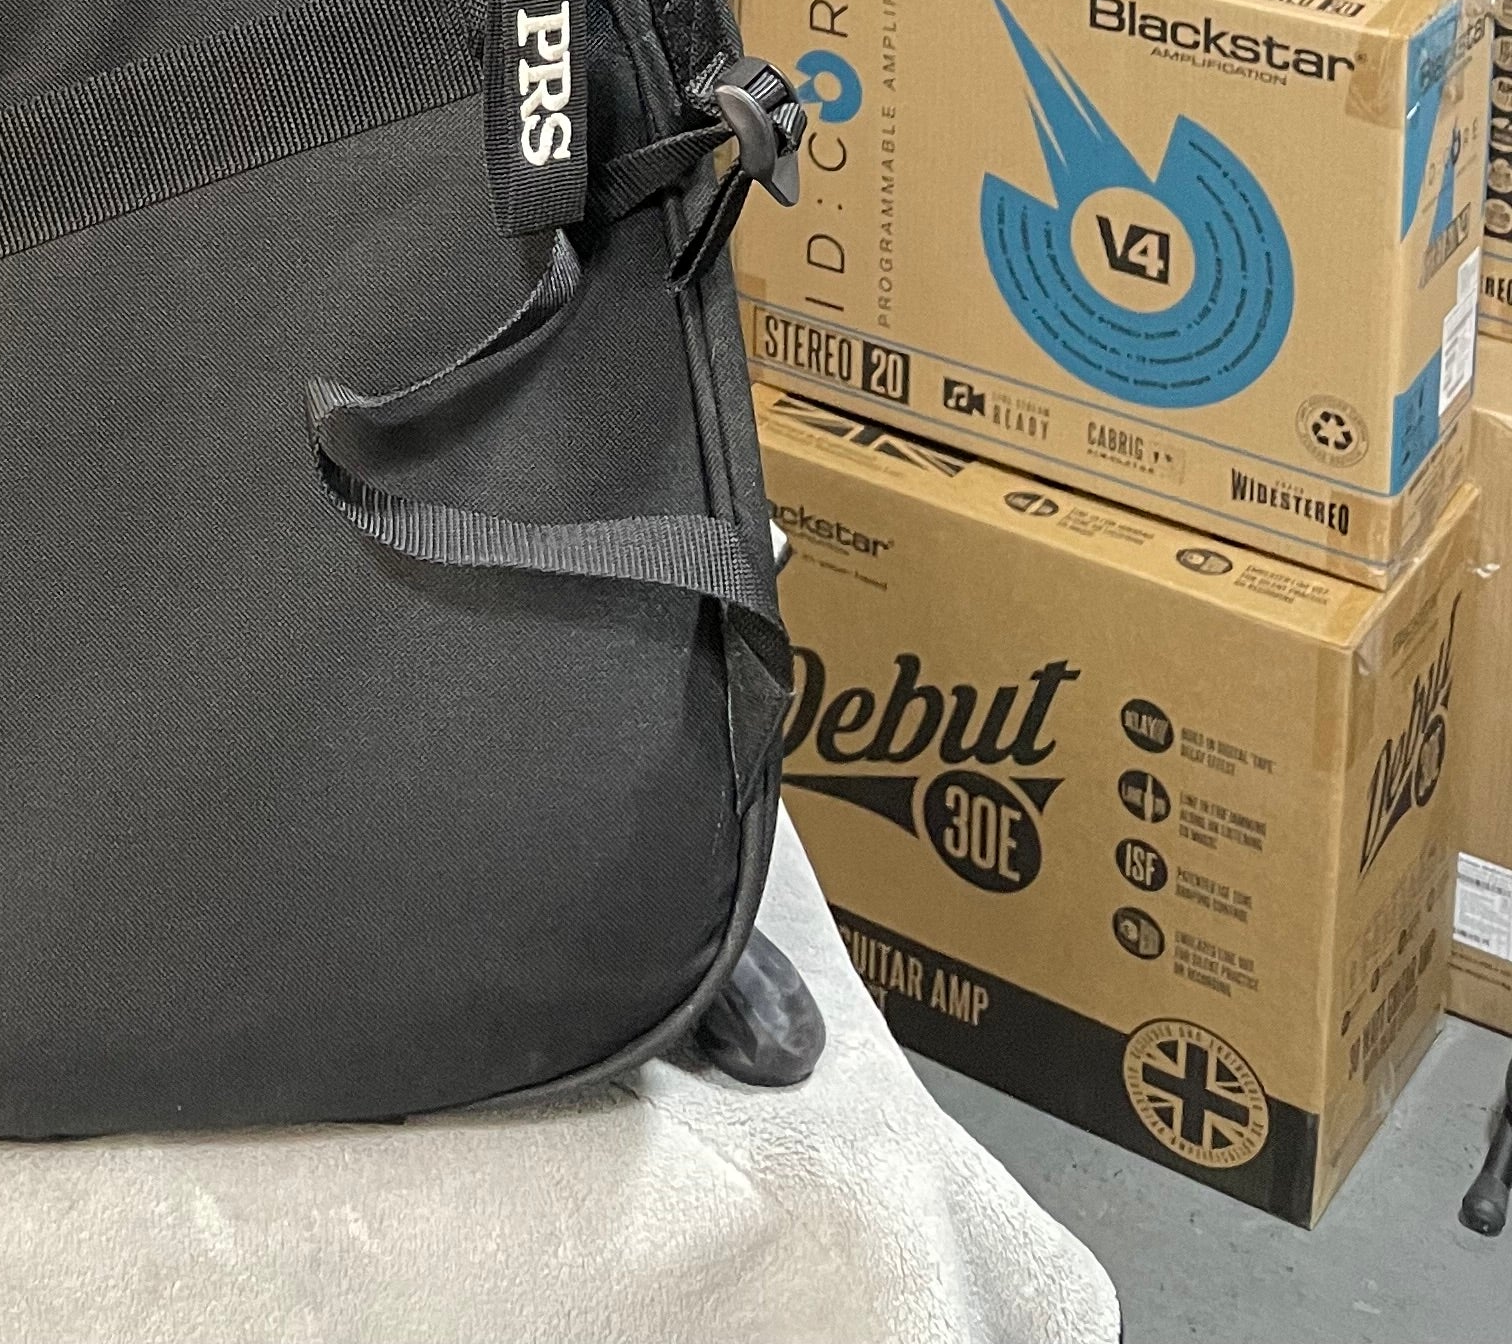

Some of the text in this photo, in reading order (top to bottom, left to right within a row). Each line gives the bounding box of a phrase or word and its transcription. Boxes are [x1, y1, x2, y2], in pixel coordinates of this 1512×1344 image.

[516, 0, 572, 166] PRS
[1149, 45, 1289, 87] AMPLIFICATION
[877, 106, 897, 328] PROGRAMMABLE
[1095, 214, 1171, 285] V4
[764, 314, 904, 399] STEREO 20
[1087, 421, 1144, 463] CABRIG
[1230, 467, 1350, 537] WIDESTEREO
[943, 784, 1022, 883] 30E
[1124, 842, 1159, 886] ISF
[930, 968, 990, 1027] AMP
